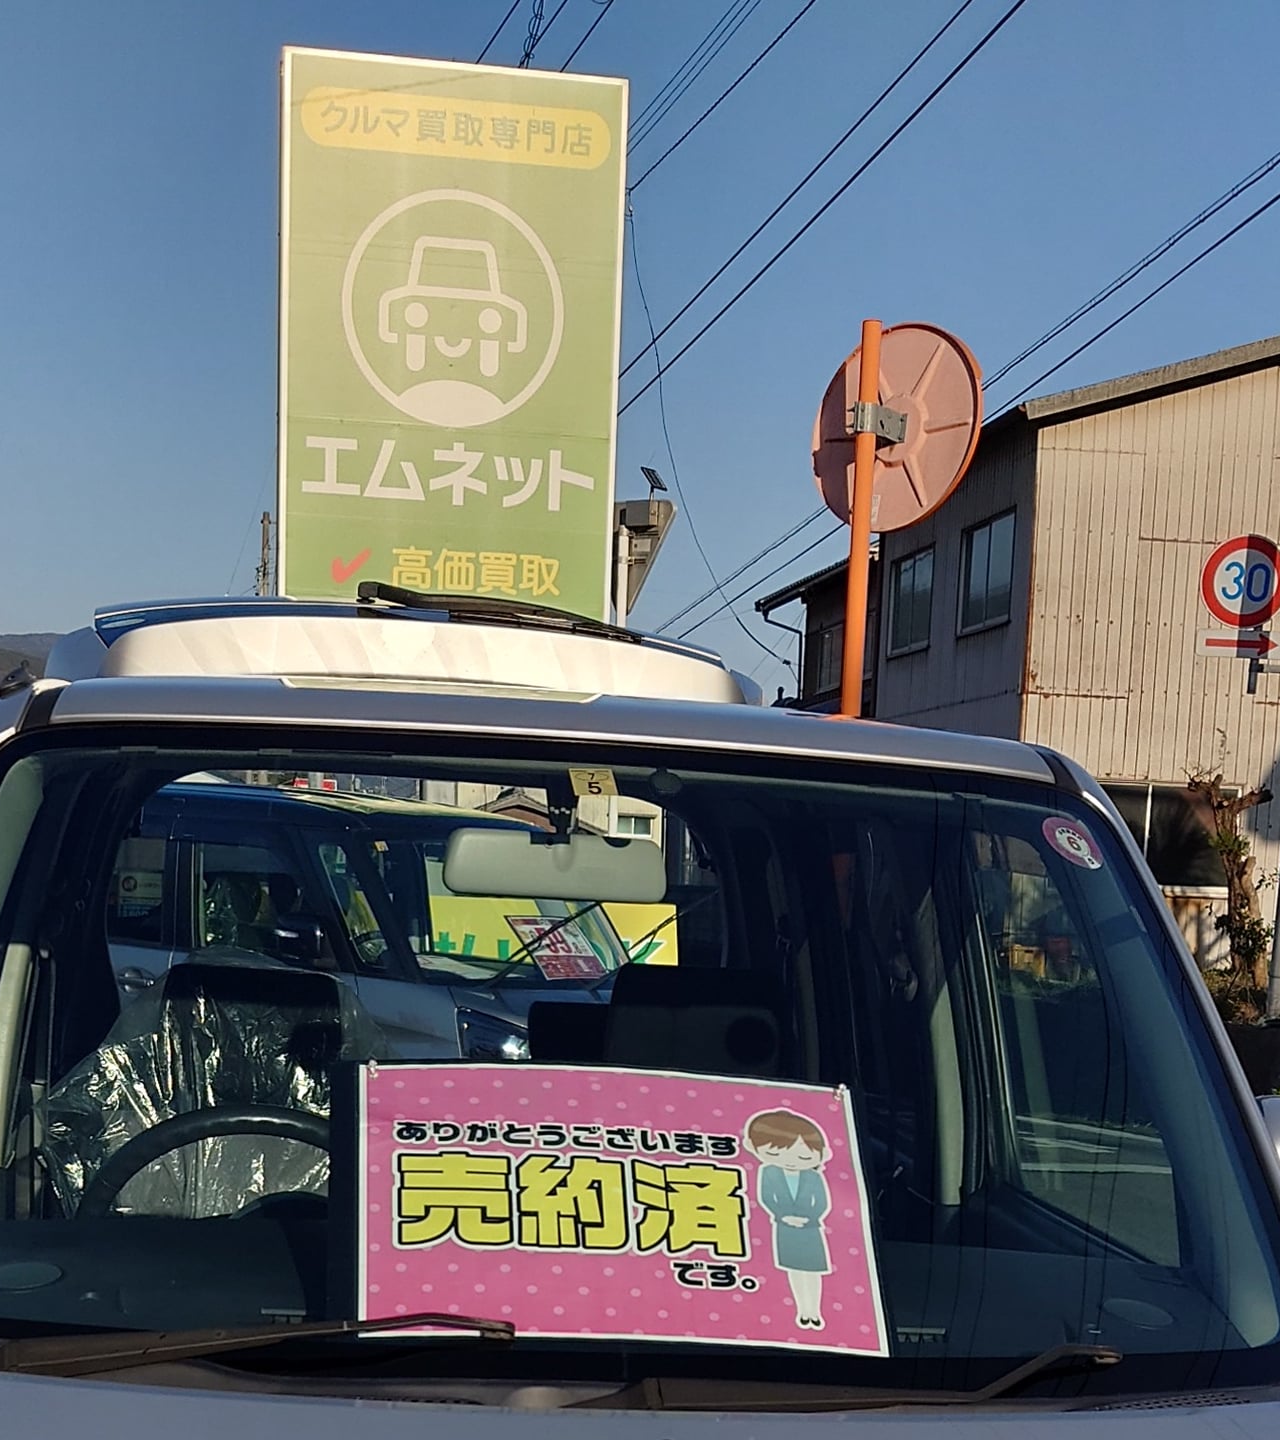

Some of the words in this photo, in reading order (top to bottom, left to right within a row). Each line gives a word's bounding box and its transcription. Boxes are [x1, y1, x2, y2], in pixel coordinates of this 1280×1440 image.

[320, 100, 592, 156] クルマ買取専門店
[302, 435, 594, 511] エムネット
[392, 547, 560, 596] 高価買取
[1222, 562, 1271, 602] 30
[588, 782, 602, 795] 5
[1067, 836, 1081, 851] 6
[395, 1121, 737, 1156] ありがとうございます
[397, 1151, 747, 1257] 売約済
[672, 1261, 758, 1291] です。
